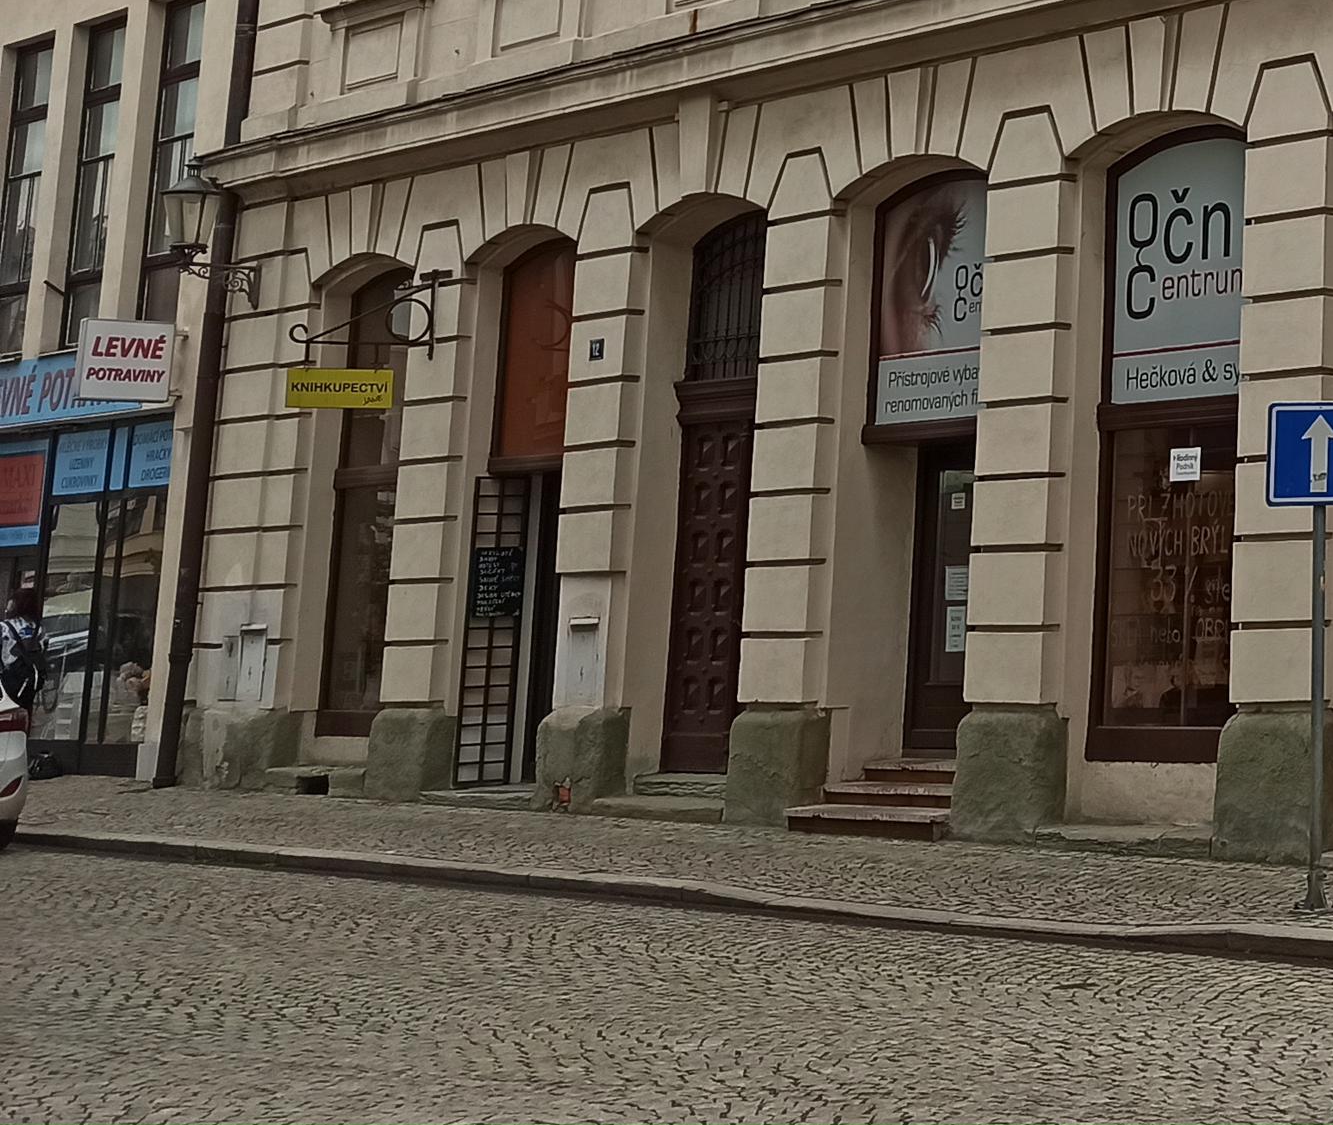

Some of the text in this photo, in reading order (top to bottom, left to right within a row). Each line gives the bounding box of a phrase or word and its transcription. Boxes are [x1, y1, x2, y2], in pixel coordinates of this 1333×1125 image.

[1128, 187, 1231, 264] Očn
[955, 263, 984, 297] Oč
[91, 334, 167, 360] LEVNÉ
[86, 367, 166, 383] POTRAVINY
[291, 381, 388, 393] KNIHKUPECTVÍ
[888, 363, 980, 389] Přístrojové vyba
[1126, 359, 1241, 390] Hečková & sy
[0, 364, 37, 417] VNÉ
[884, 391, 968, 414] renomovaných
[1190, 520, 1229, 556] BRÝL
